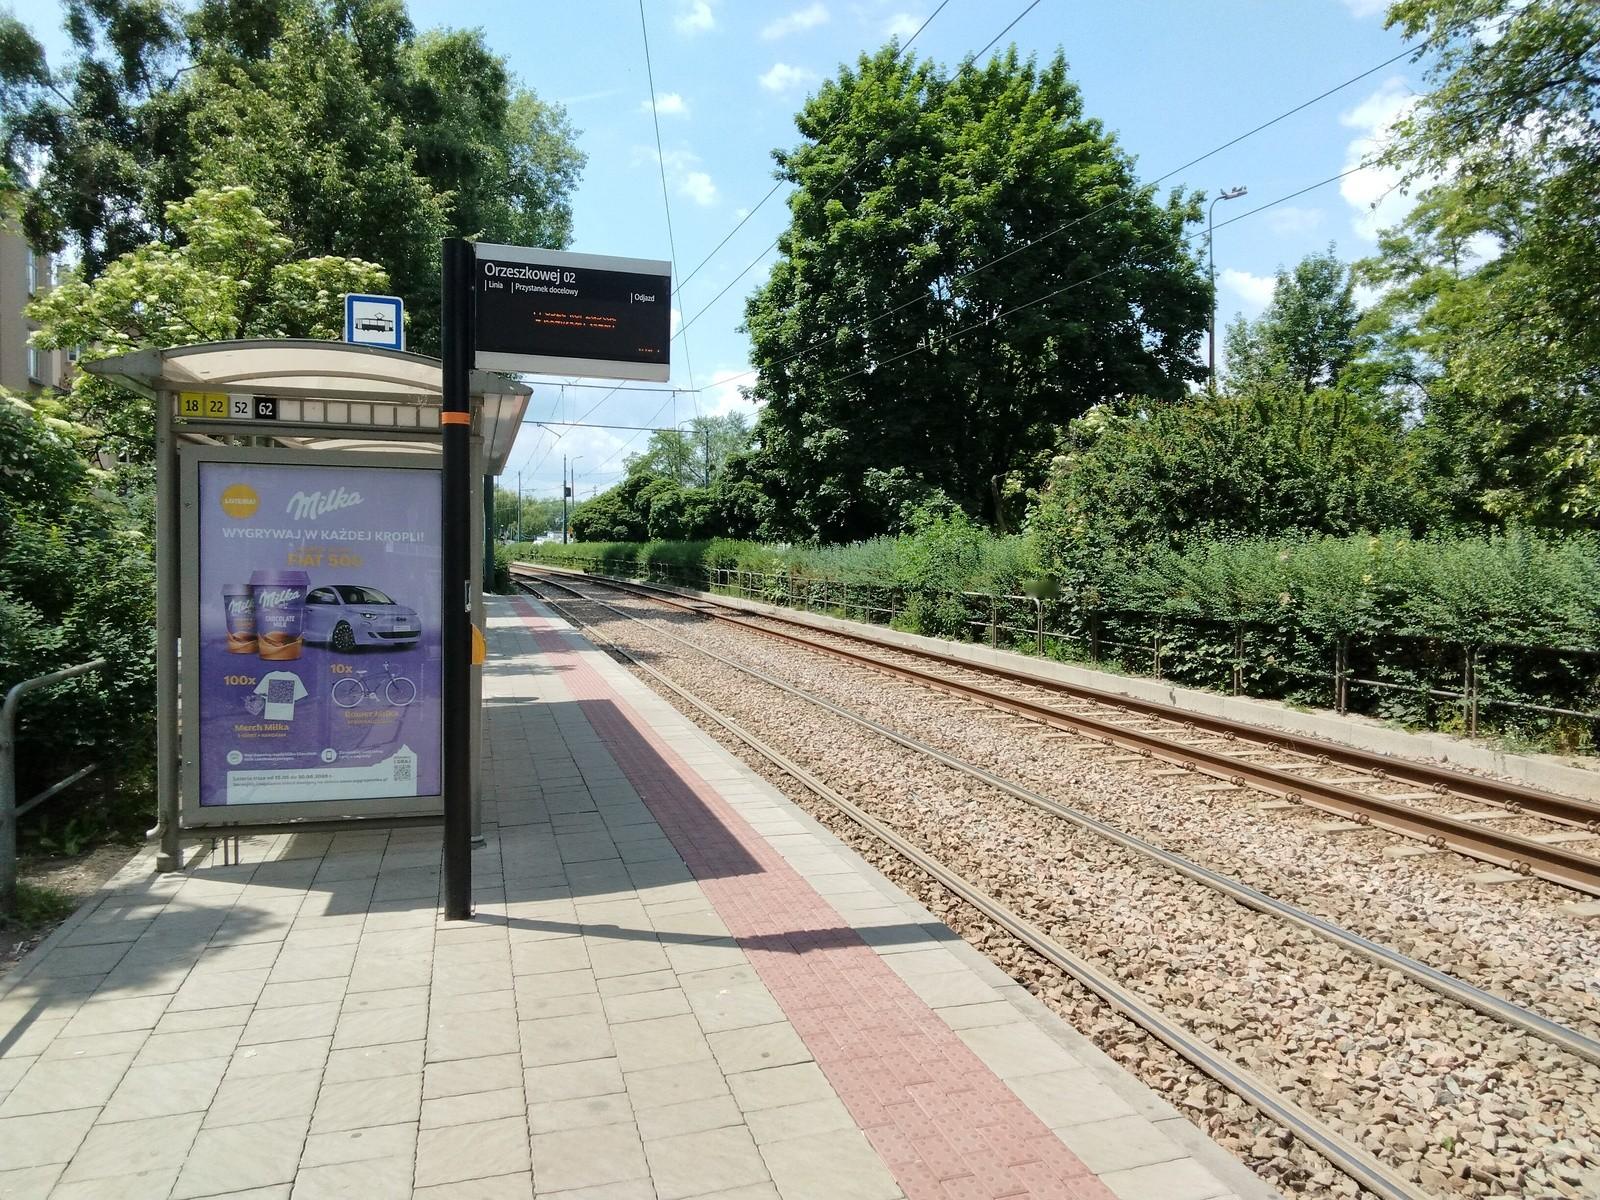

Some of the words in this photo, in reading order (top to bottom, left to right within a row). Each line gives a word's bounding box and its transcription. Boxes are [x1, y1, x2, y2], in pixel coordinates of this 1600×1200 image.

[484, 262, 561, 285] Orzeszkowej
[563, 271, 576, 284] 02
[488, 280, 504, 289] Linia
[515, 283, 549, 294] Przystanek
[549, 286, 579, 297] docelowy
[634, 293, 655, 302] Odjazd
[185, 400, 199, 412] 18
[210, 400, 223, 413] 22
[234, 401, 248, 414] 52
[258, 402, 273, 415] 62
[286, 486, 364, 520] Milka
[222, 527, 301, 540] WYGRYWAJ
[304, 529, 318, 540] W
[320, 528, 372, 541] KAŻDEJ
[375, 531, 425, 543] KROPLI!
[258, 588, 301, 609] Milka
[265, 615, 295, 623] CHOCOLATE
[330, 663, 353, 674] 10x
[223, 675, 257, 686] 100x
